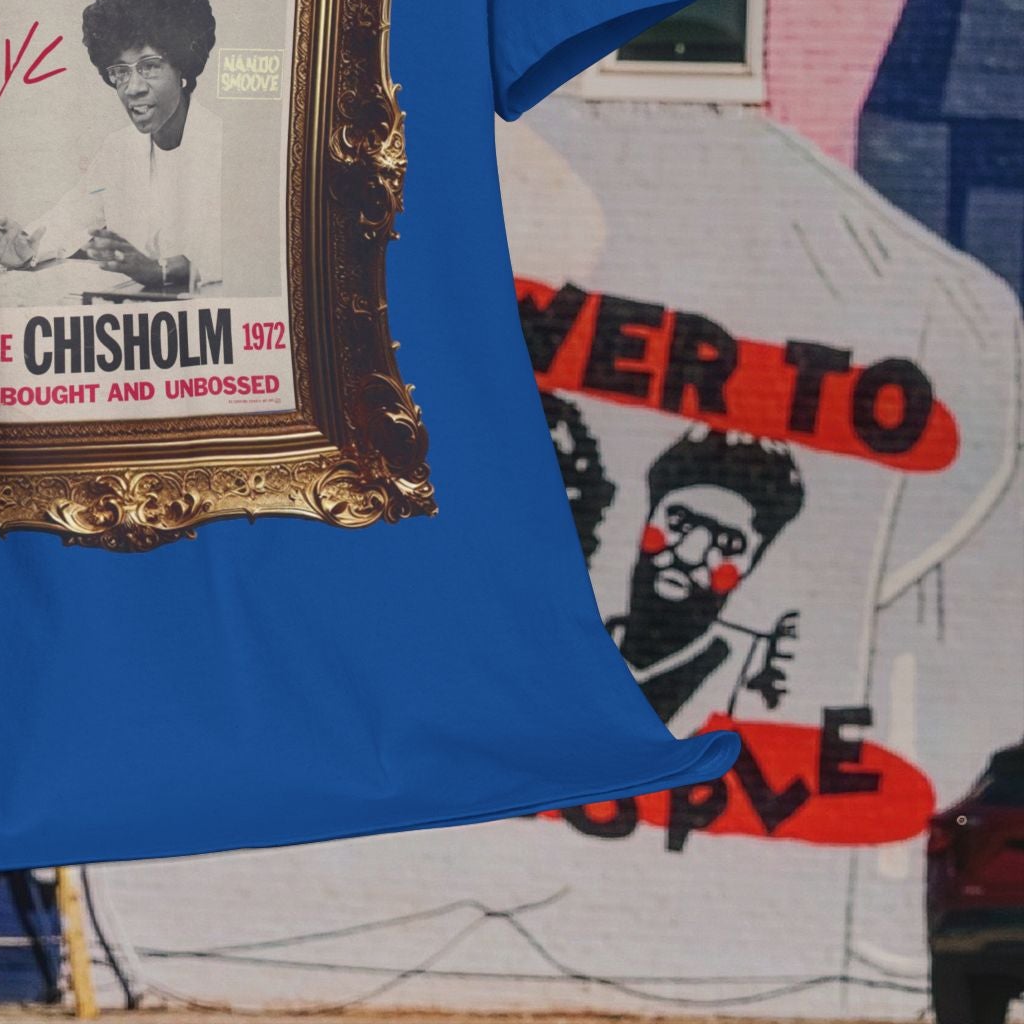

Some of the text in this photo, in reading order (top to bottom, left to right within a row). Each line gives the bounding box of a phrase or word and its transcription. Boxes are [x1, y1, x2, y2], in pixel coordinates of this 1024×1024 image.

[23, 308, 234, 375] CHISHOLM
[242, 321, 286, 351] 1972
[107, 381, 155, 403] AND
[164, 374, 280, 400] UNBOSSED
[785, 339, 933, 455] TO
